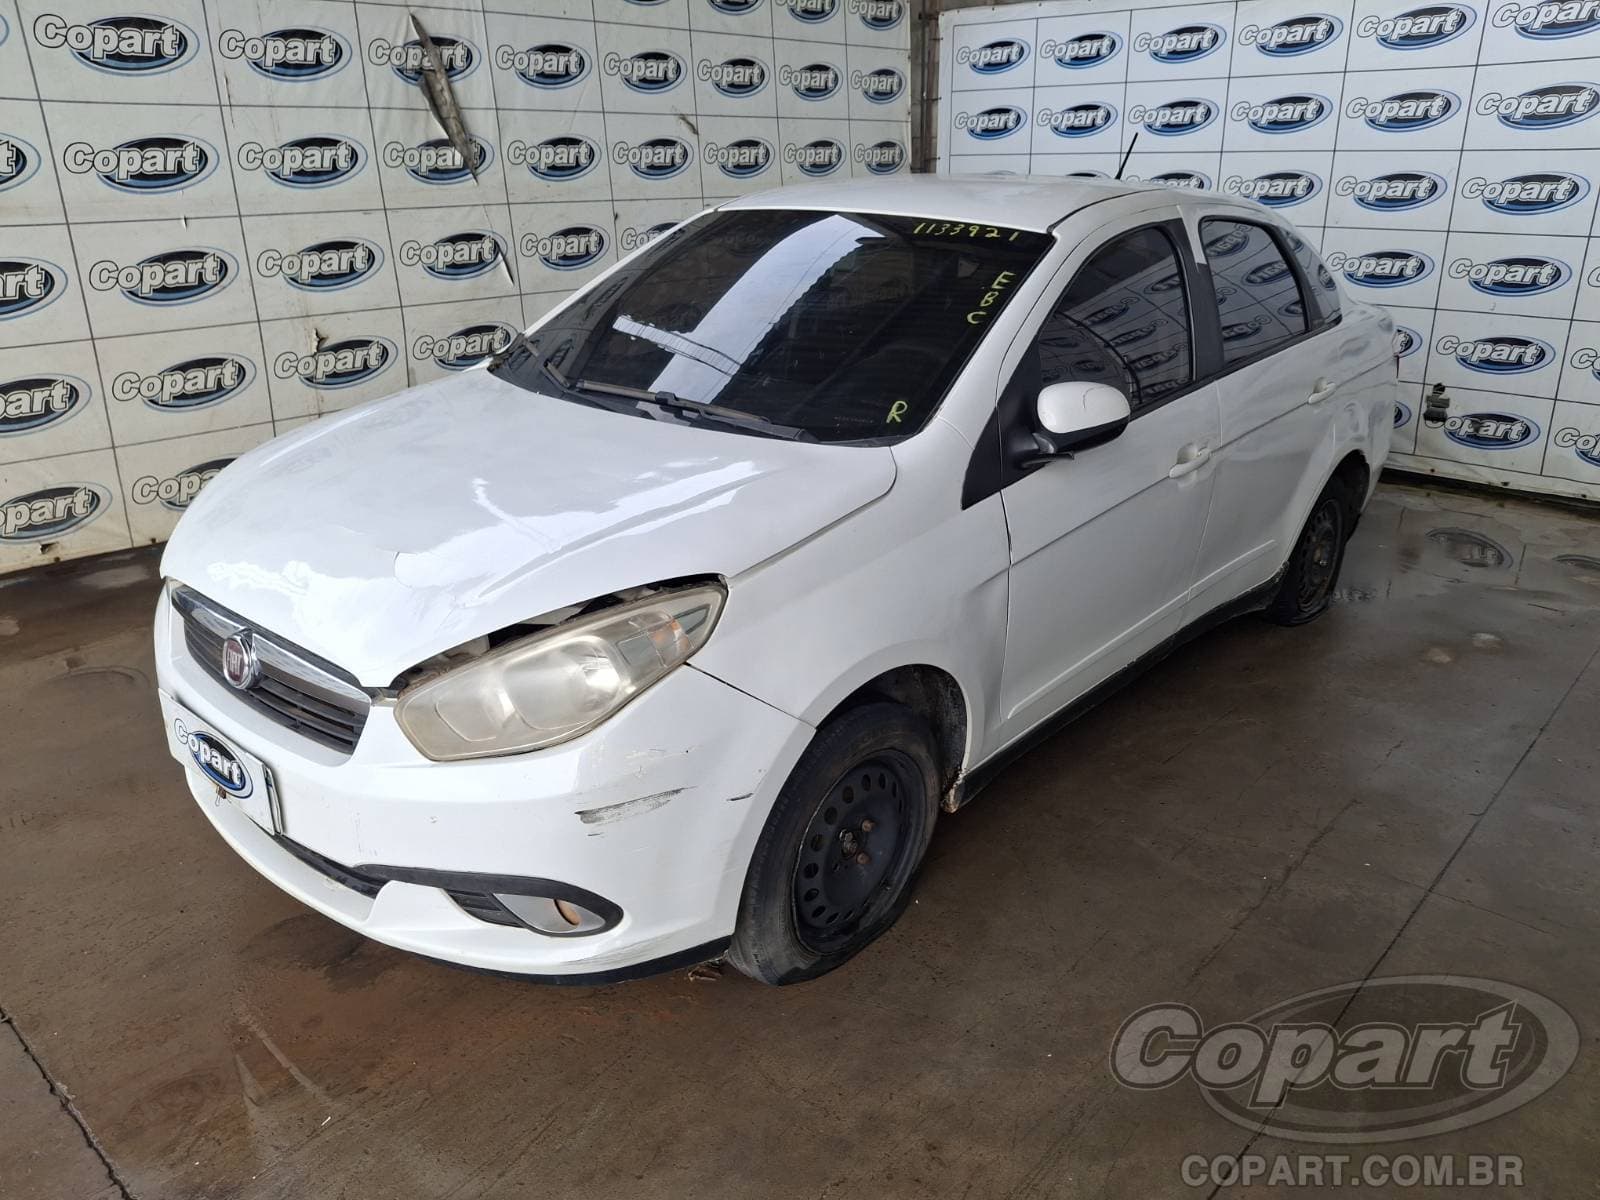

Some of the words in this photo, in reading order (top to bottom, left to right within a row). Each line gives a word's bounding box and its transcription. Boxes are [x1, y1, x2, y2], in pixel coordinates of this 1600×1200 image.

[33, 13, 180, 60] Copart
[1239, 17, 1332, 50] Copart
[1357, 7, 1462, 42] Copart
[219, 29, 336, 67] Copart
[956, 40, 1024, 67] Copart
[1041, 34, 1116, 62] Copart
[1134, 26, 1216, 55] Copart
[496, 44, 581, 79] Copart
[604, 52, 678, 83] Copart
[698, 59, 763, 88] Copart
[779, 65, 836, 92] Copart
[851, 70, 900, 96] Copart
[1036, 104, 1108, 133] Copart
[1129, 99, 1212, 129] Copart
[1231, 97, 1321, 127] Copart
[1345, 94, 1450, 122] Copart
[1476, 87, 1595, 121] Copart
[954, 109, 1020, 137] Copart
[63, 141, 199, 181] Copart
[238, 141, 350, 178] Copart
[508, 140, 590, 170] Copart
[613, 141, 685, 170] Copart
[704, 143, 768, 168] Copart
[784, 143, 839, 168] Copart
[854, 143, 901, 167] Copart
[1223, 175, 1310, 199] Copart
[1335, 176, 1436, 203] Copart
[1462, 176, 1575, 205] Copart
[400, 234, 496, 271] Copart
[520, 229, 601, 261] Copart
[90, 253, 220, 296] Copart
[257, 243, 369, 281] Copart
[1326, 251, 1421, 278] Copart
[1448, 258, 1557, 286] Copart
[413, 326, 506, 362] Copart
[1436, 335, 1545, 365] Copart
[274, 340, 382, 382] Copart
[112, 358, 240, 403] Copart
[886, 401, 908, 423] R
[0, 486, 92, 535] part
[174, 718, 243, 786] Copart
